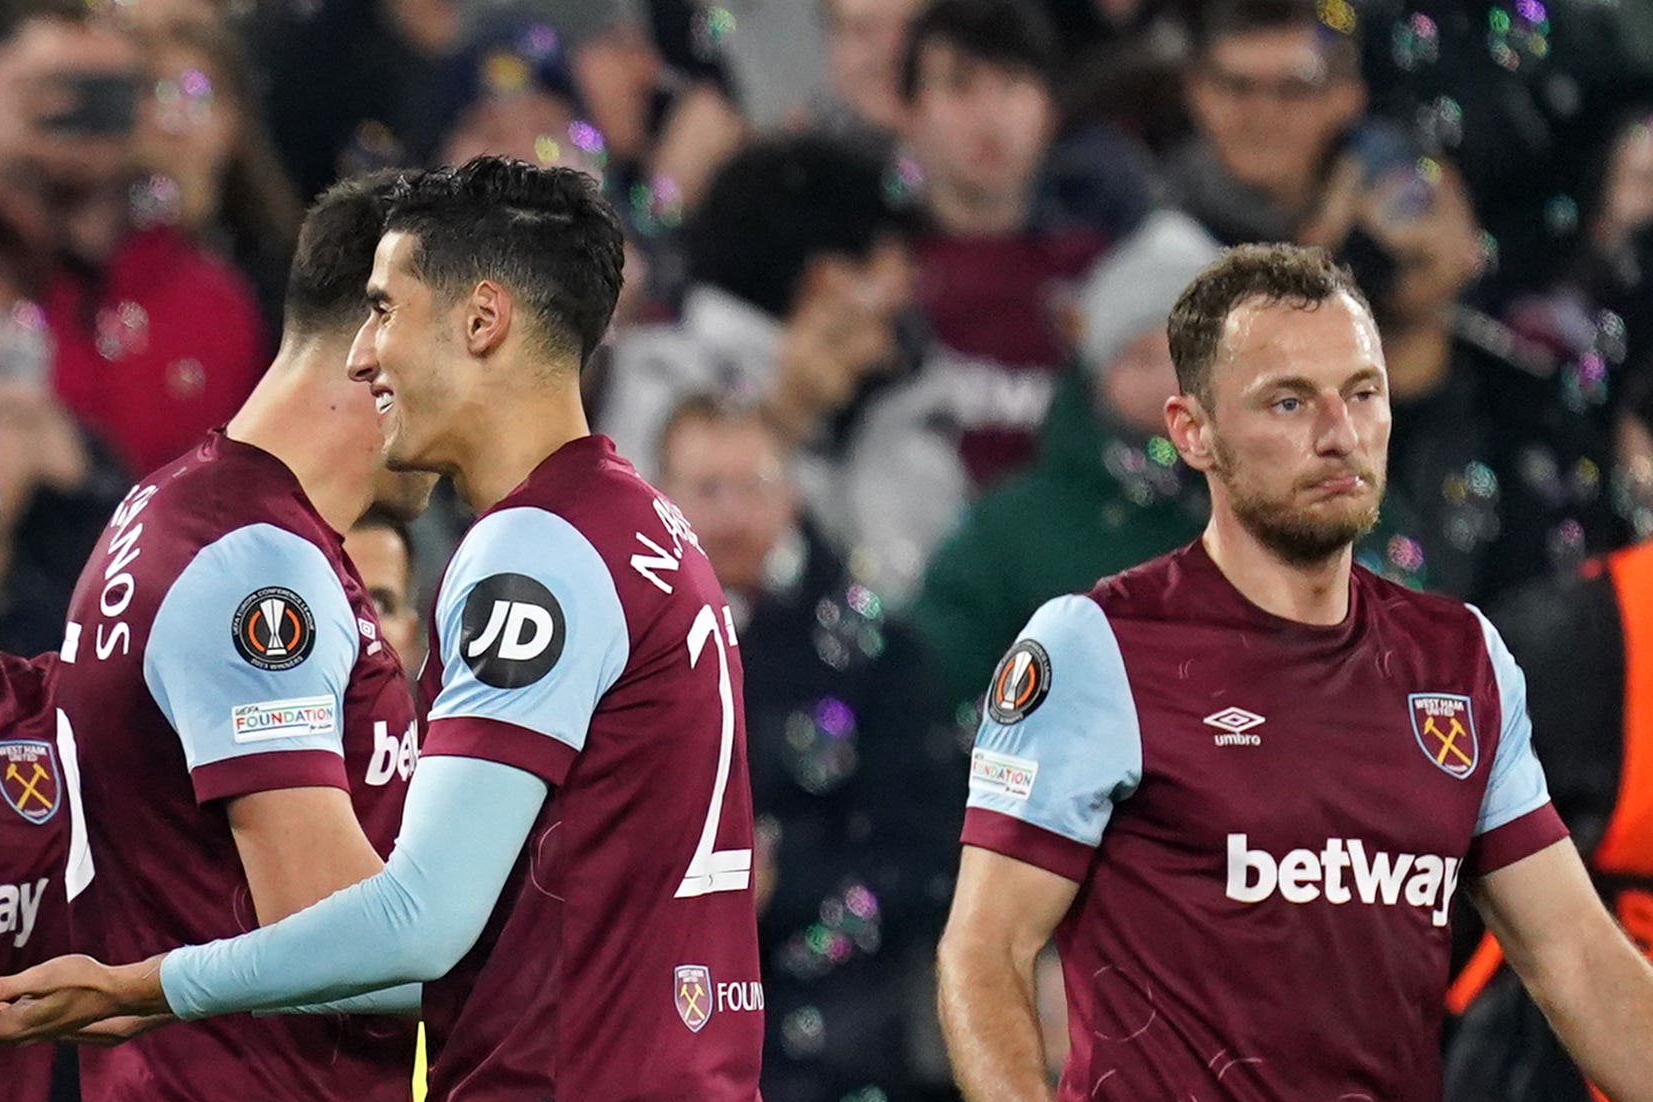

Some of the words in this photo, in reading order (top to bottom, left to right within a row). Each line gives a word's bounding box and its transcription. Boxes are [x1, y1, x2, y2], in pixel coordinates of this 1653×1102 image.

[468, 600, 554, 661] JD
[1414, 699, 1439, 710] WEST
[1440, 700, 1465, 711] HAM
[236, 707, 333, 731] FOUNDATION
[1214, 732, 1262, 747] umbro
[1225, 833, 1465, 927] betway
